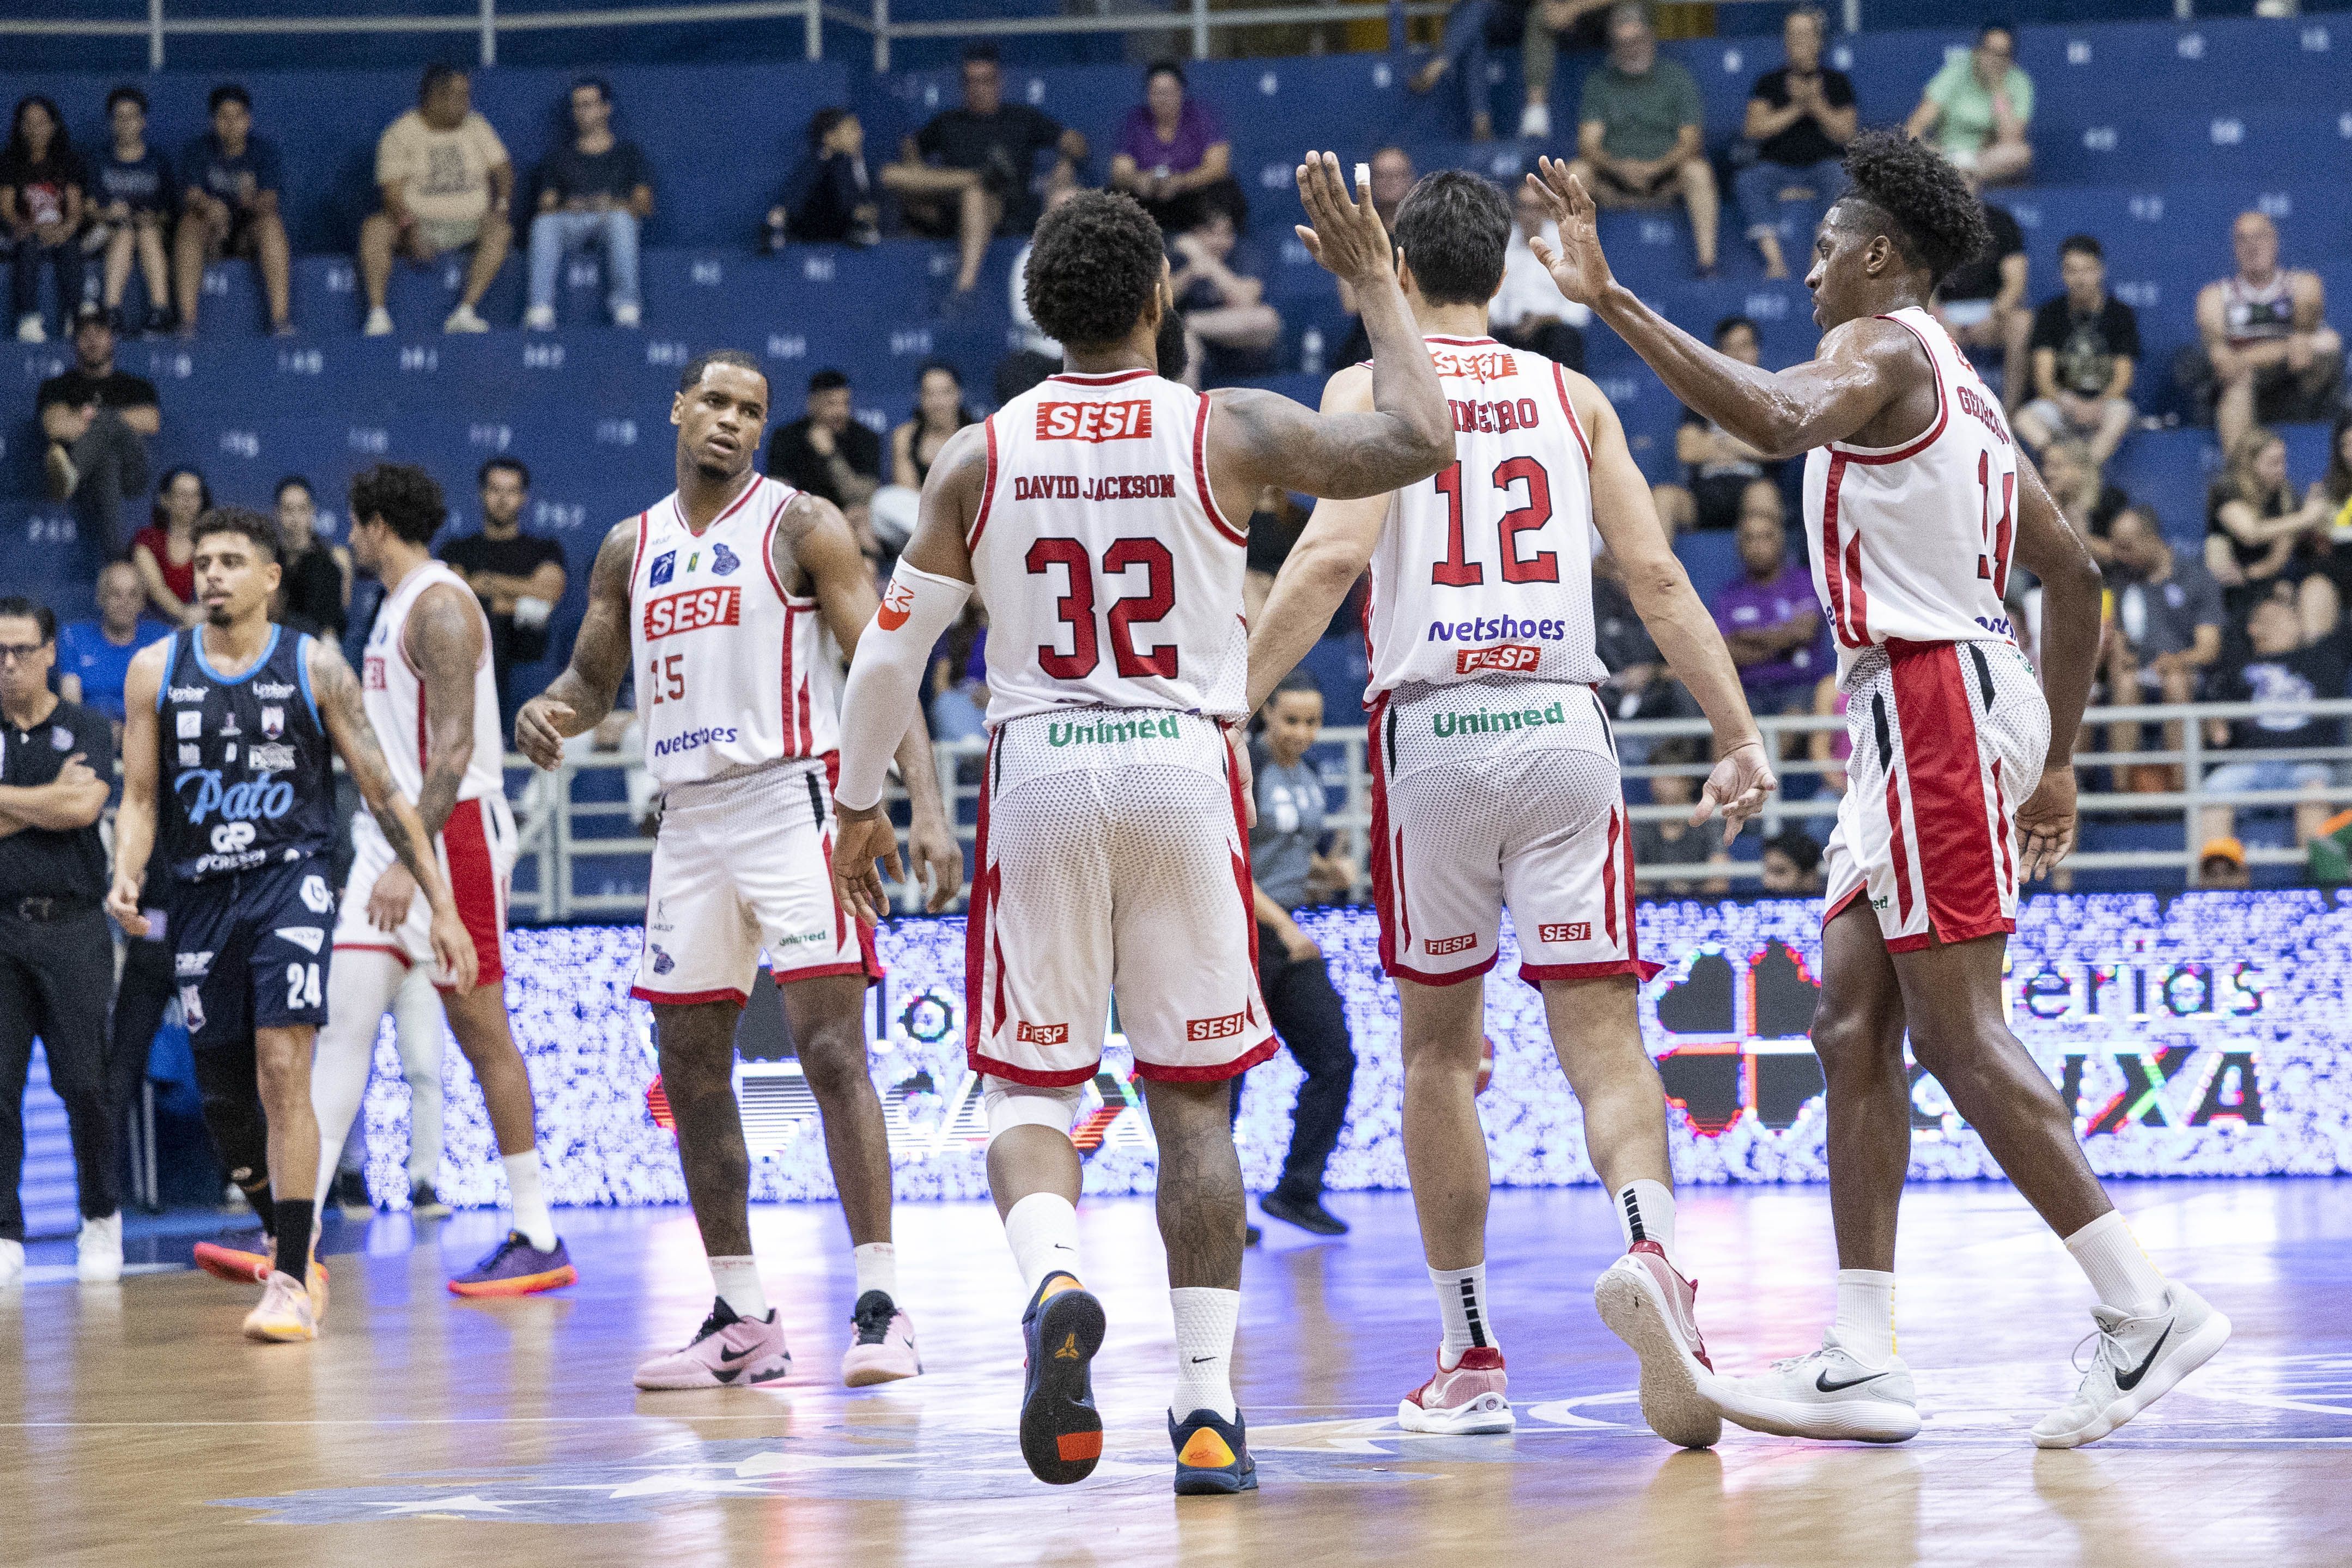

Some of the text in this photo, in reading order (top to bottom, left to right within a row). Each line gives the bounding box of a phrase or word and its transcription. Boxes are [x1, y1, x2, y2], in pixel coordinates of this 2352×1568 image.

[1432, 353, 1503, 380] SESI
[1047, 404, 1141, 440] SESI
[1447, 398, 1539, 434] INEIRO
[1014, 474, 1176, 501] DAVID JACKSON
[1432, 455, 1559, 586] 12
[651, 590, 731, 636] SESI
[1025, 537, 1178, 679] 32
[1463, 648, 1535, 672] FIESP
[651, 654, 685, 704] 15
[1049, 715, 1181, 747] Unimed
[1433, 702, 1566, 738] Unimed
[174, 768, 294, 825] Pato
[1429, 936, 1473, 953] FIESP
[1543, 925, 1586, 941] SESI
[287, 963, 321, 1009] 24
[1022, 1023, 1064, 1044] FIESP
[1193, 1017, 1242, 1039] SESI
